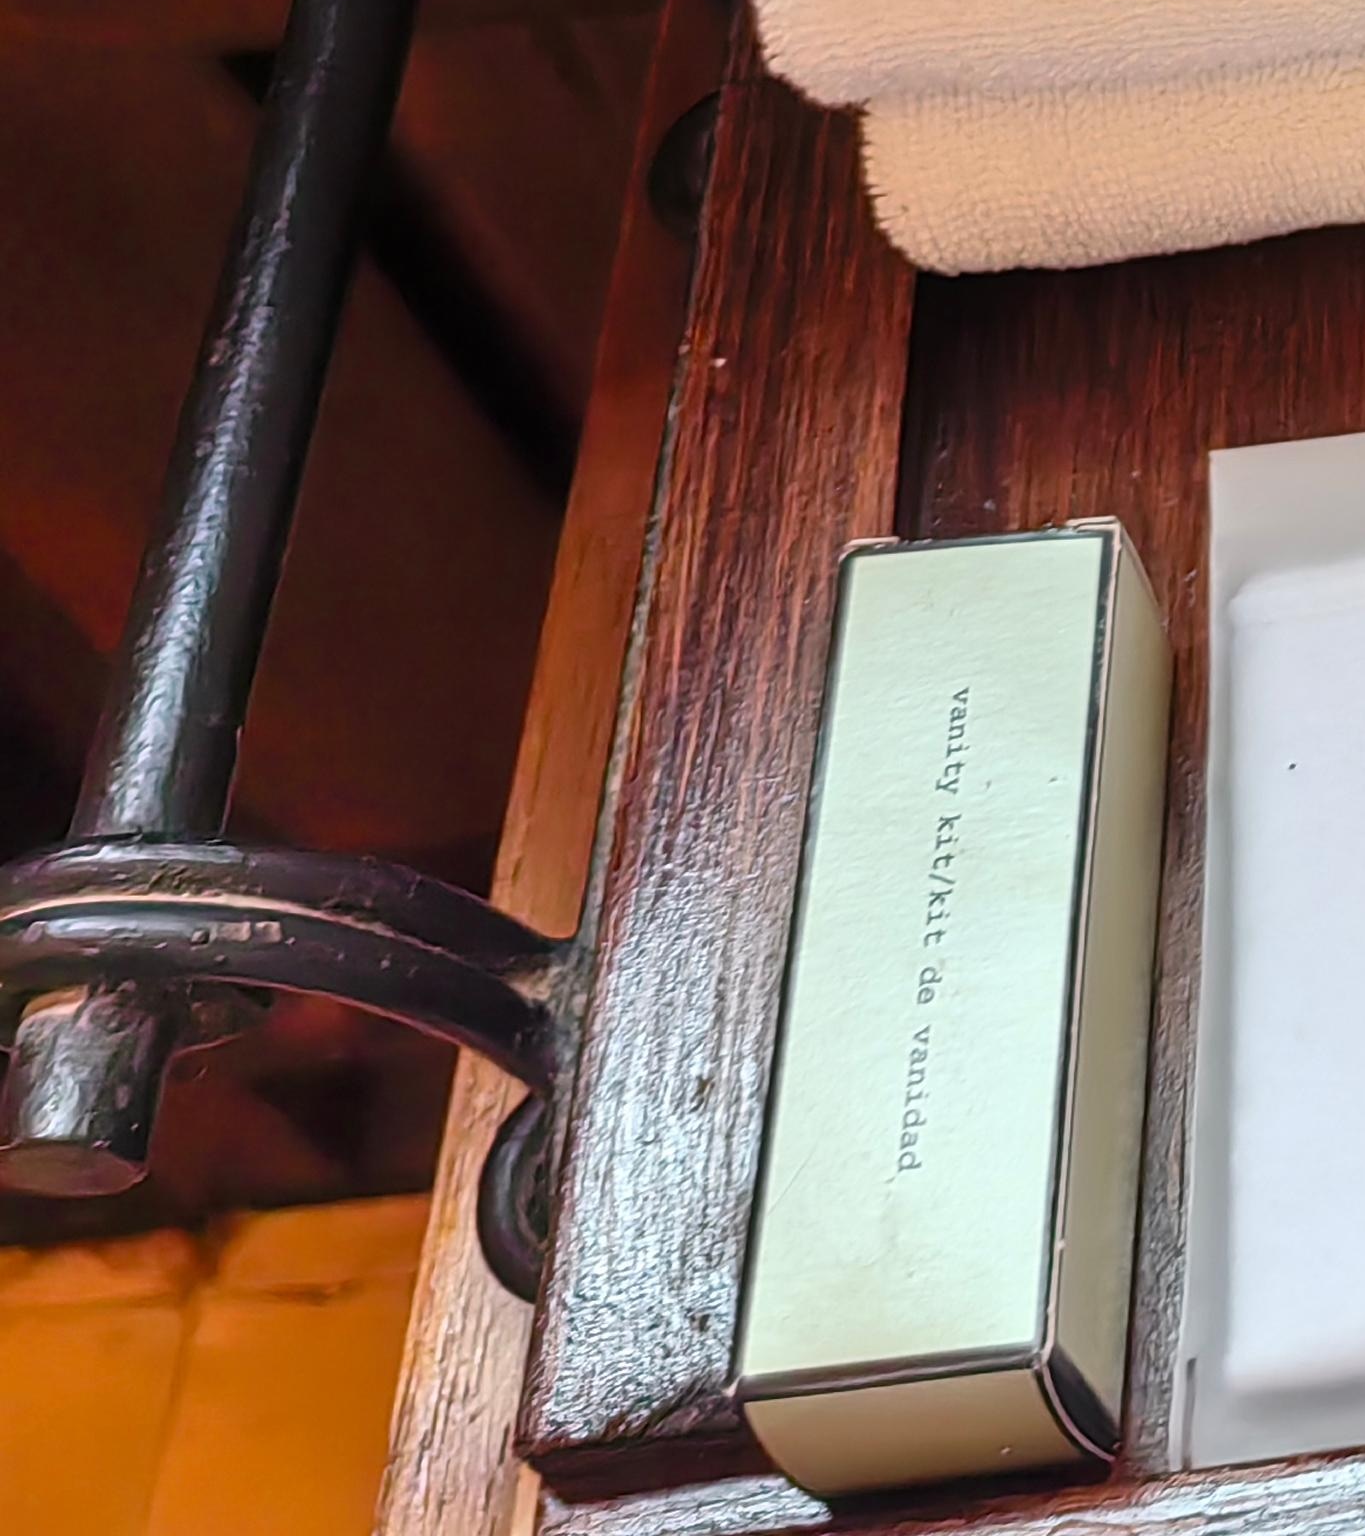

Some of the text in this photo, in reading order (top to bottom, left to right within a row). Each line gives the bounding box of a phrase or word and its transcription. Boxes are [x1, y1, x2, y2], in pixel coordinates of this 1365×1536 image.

[897, 686, 970, 1173] vanity kit/kit de vanidad
